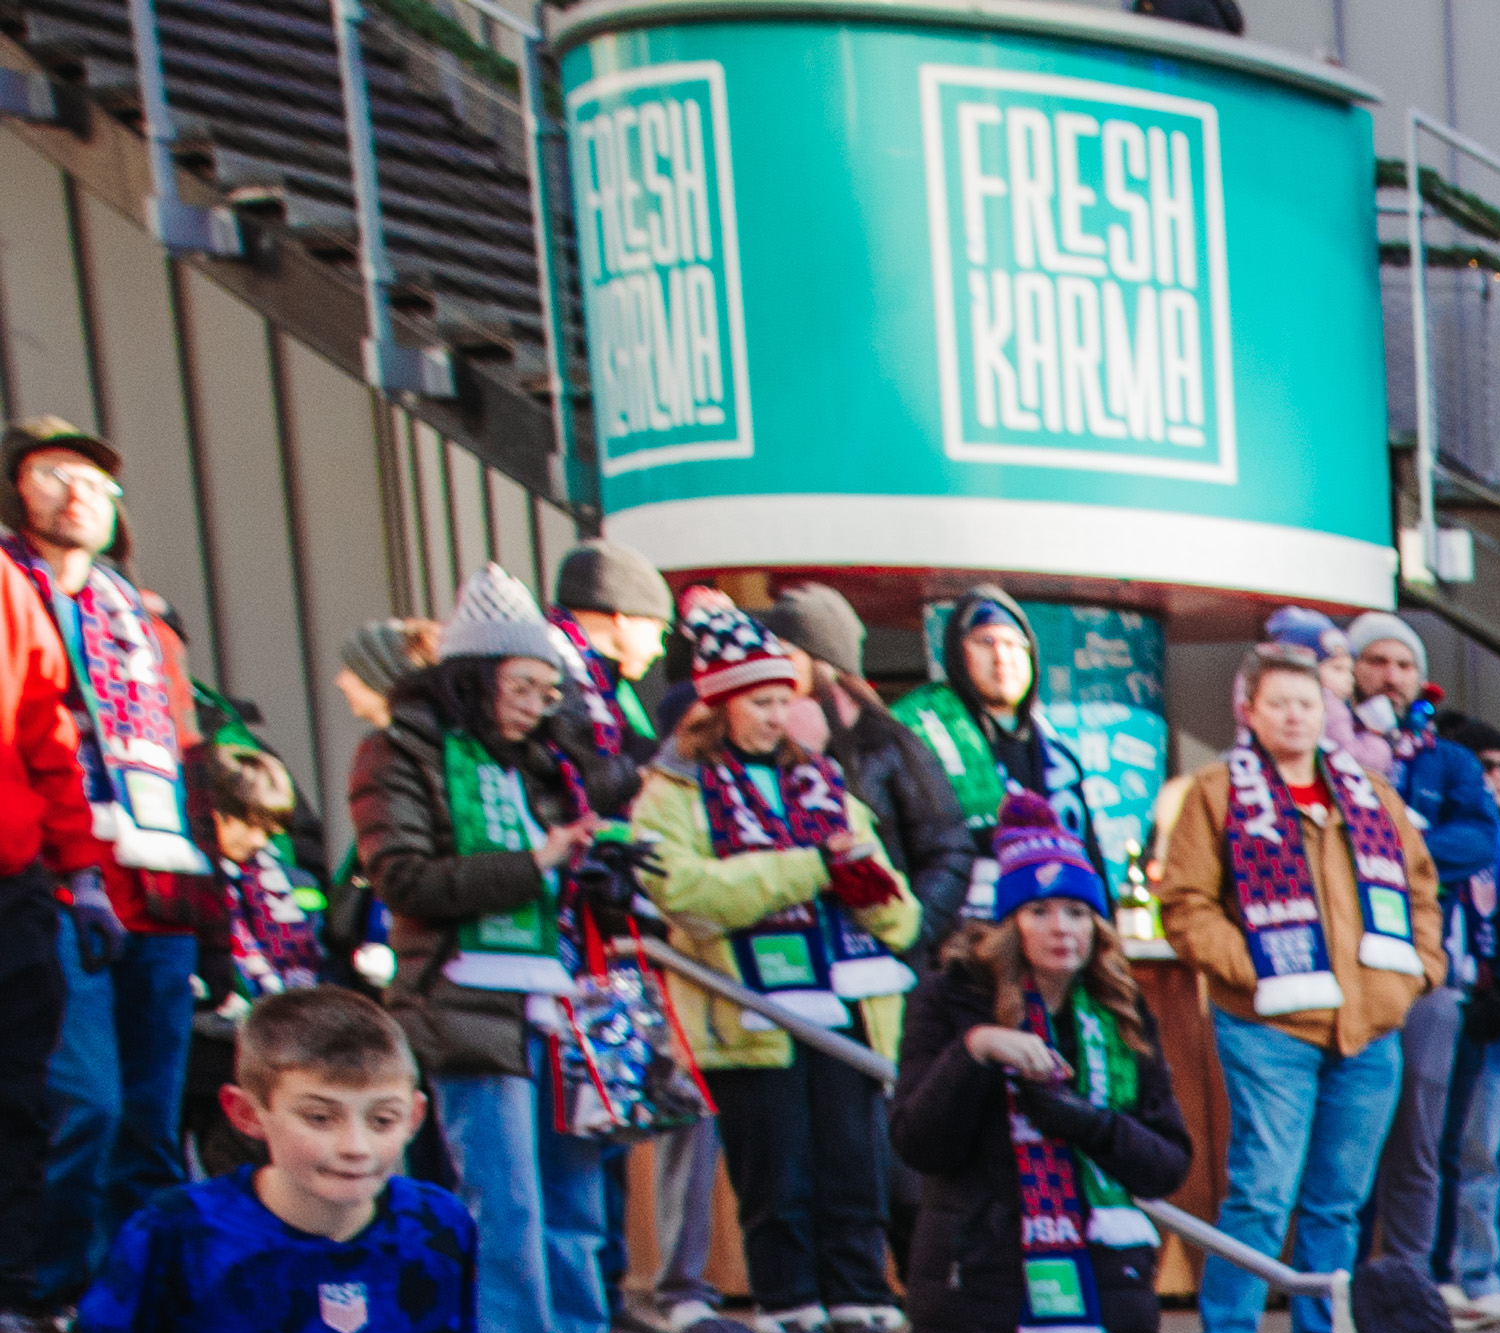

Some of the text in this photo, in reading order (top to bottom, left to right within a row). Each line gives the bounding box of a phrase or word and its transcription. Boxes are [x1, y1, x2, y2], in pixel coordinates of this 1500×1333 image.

[580, 97, 713, 277] FRESH
[955, 100, 1199, 289] FRESH
[968, 269, 1207, 448] KARMA
